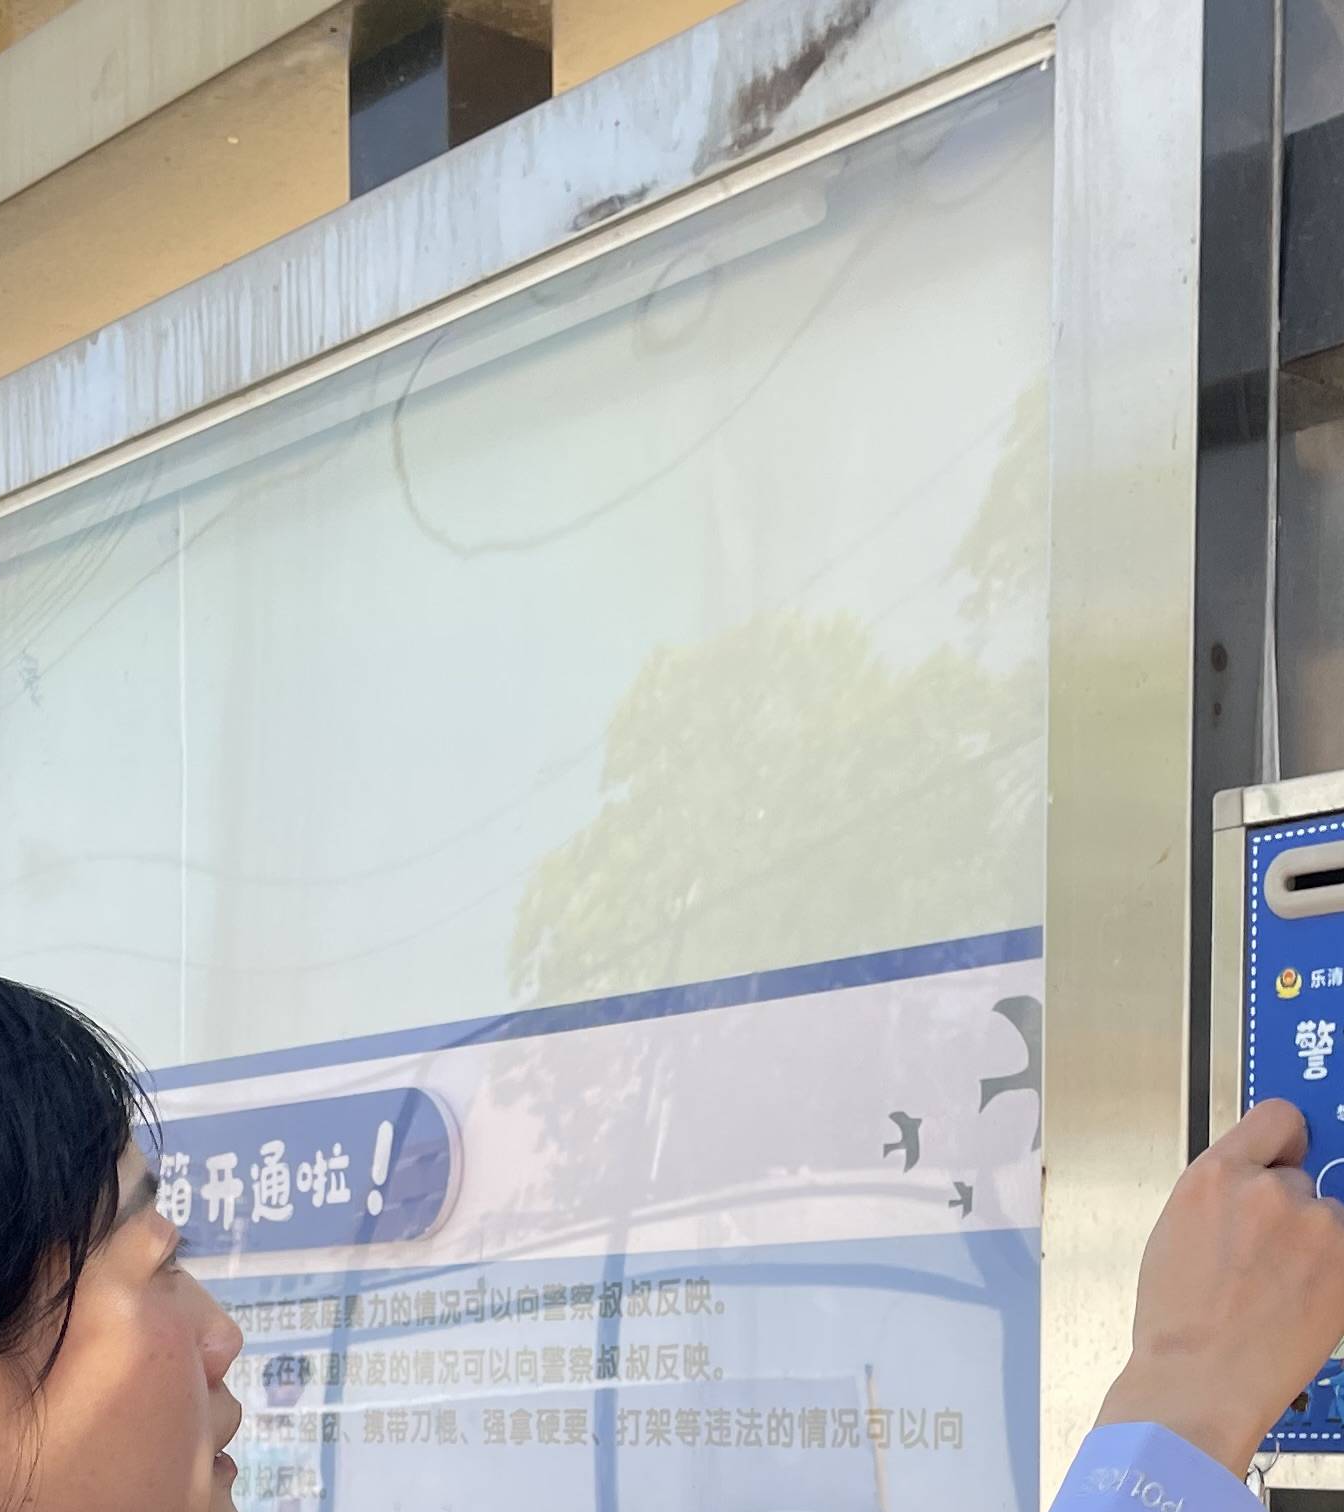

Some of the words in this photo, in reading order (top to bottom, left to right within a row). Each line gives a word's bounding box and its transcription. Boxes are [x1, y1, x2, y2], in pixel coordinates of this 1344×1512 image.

[222, 1275, 725, 1333] 内存在家庭暴力的情况可以向警察叔叔反映。
